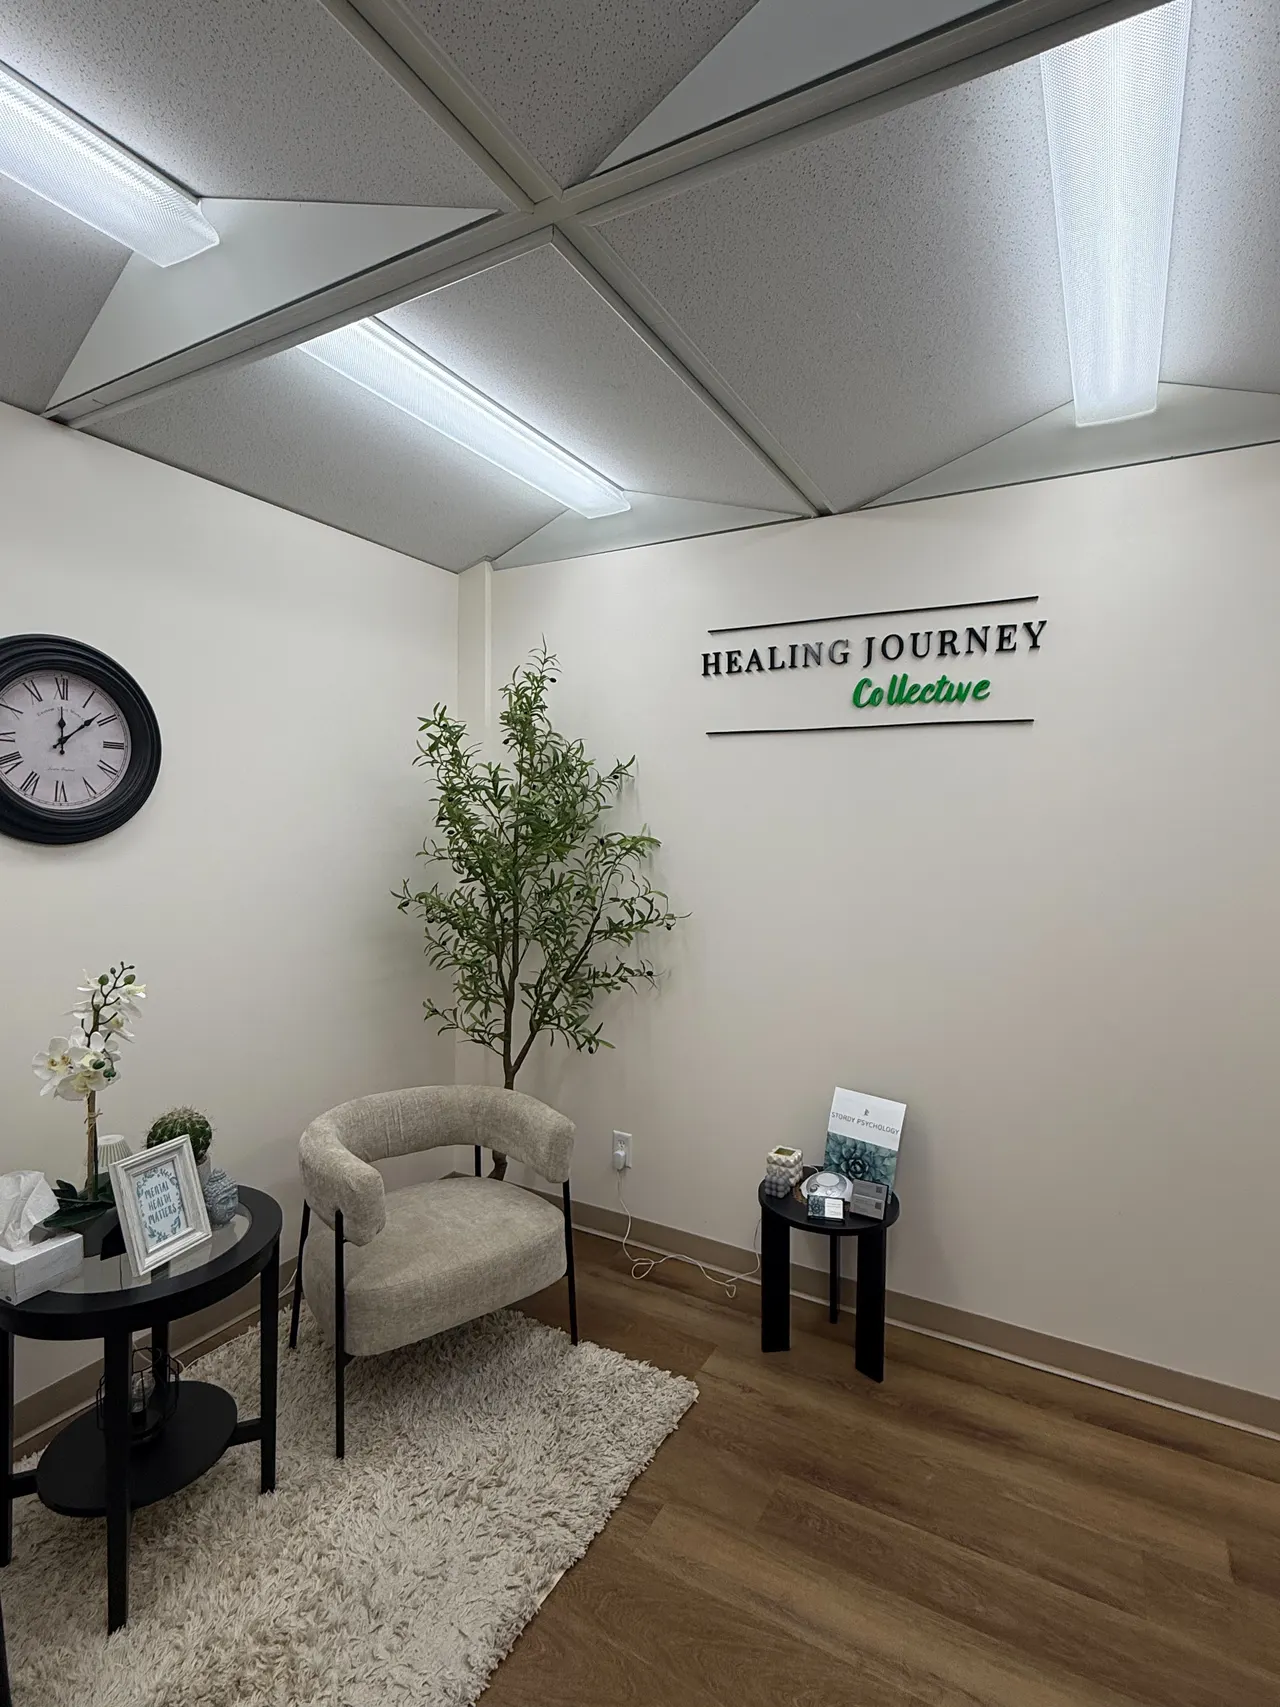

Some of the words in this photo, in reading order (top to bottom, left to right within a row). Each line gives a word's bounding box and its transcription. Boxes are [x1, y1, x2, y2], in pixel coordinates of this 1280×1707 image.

[701, 638, 850, 676] HEALING
[862, 619, 1048, 669] JOURNEY
[852, 673, 991, 708] Collective
[856, 1118, 900, 1135] PSYCHOLOGY
[144, 1181, 169, 1199] MENTAL
[147, 1193, 172, 1210] HEALTH
[148, 1202, 177, 1225] MATTERS
